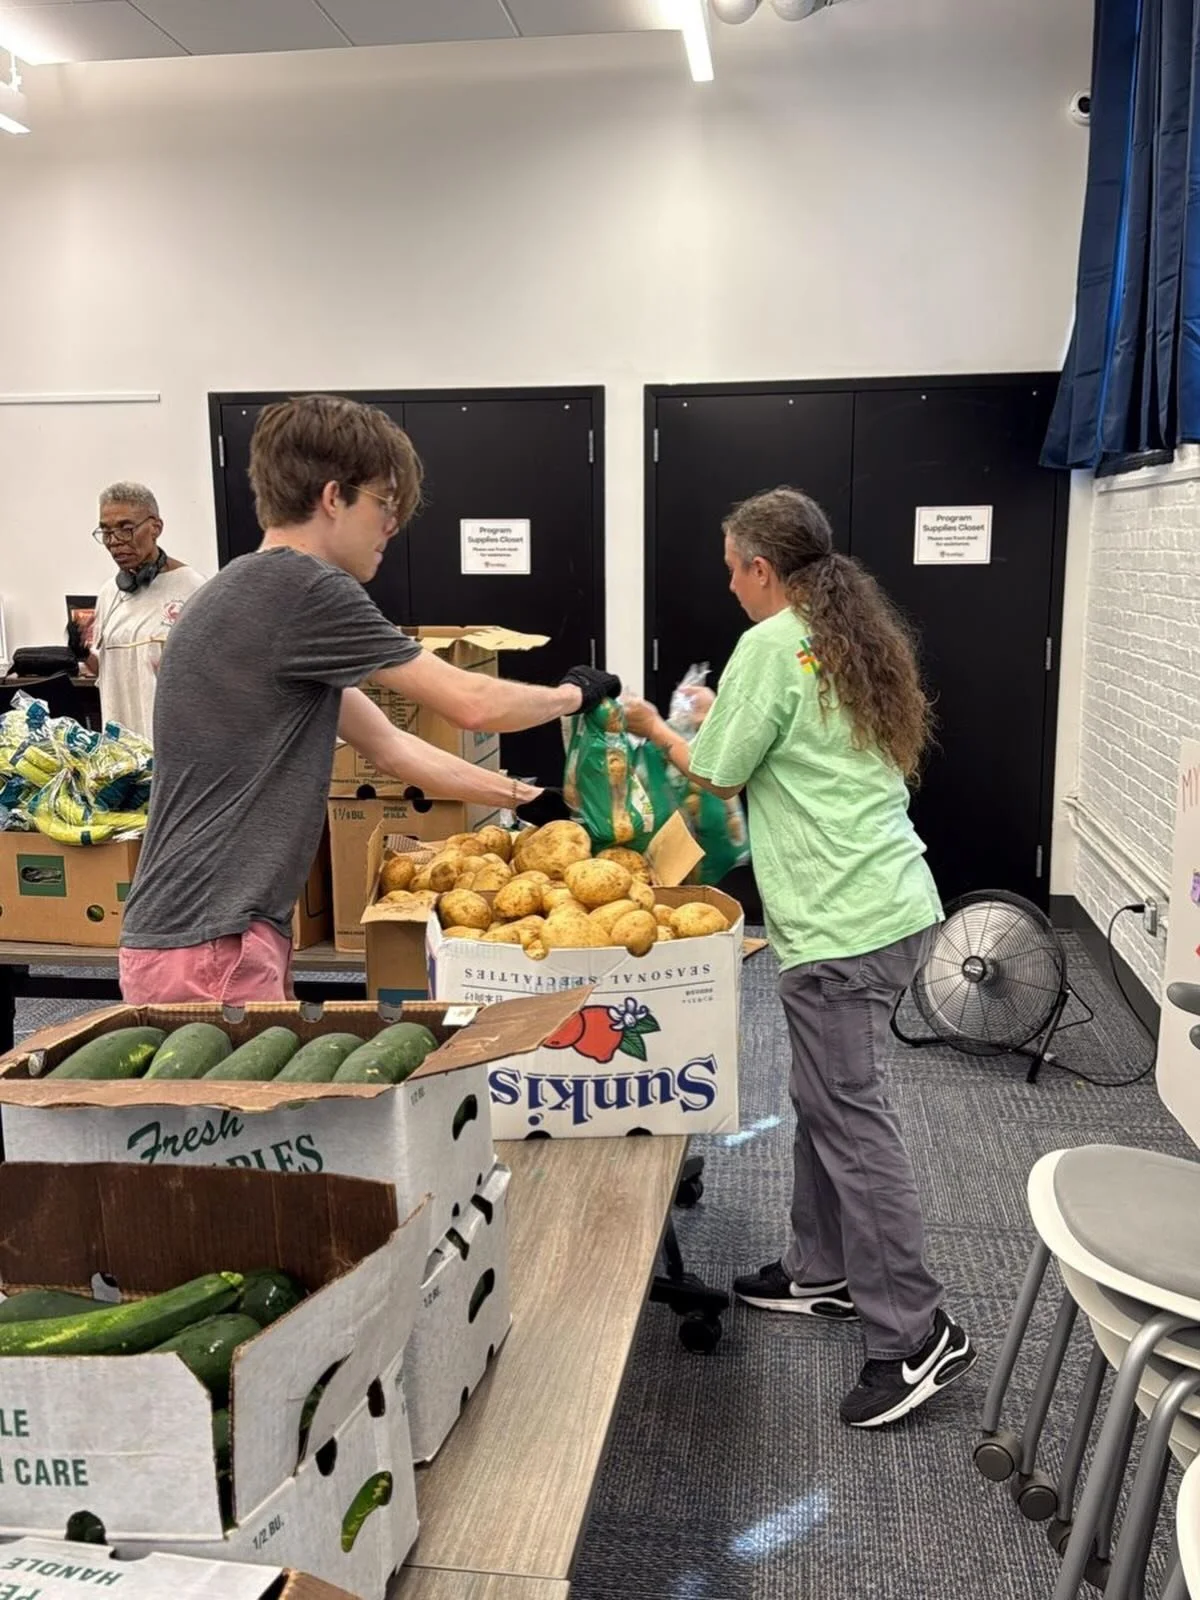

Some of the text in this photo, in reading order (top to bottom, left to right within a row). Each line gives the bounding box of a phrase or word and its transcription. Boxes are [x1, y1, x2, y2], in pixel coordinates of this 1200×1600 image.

[923, 524, 956, 533] Supplies
[936, 514, 972, 523] Program
[468, 536, 498, 544] Supplies
[479, 527, 512, 535] Program
[464, 964, 711, 986] SEASONAL SPECIALTIES
[127, 1110, 244, 1164] Fresh
[14, 1458, 89, 1486] CARE
[252, 1514, 284, 1550] 1/2 BU.
[2, 1558, 124, 1585] HANDLE
